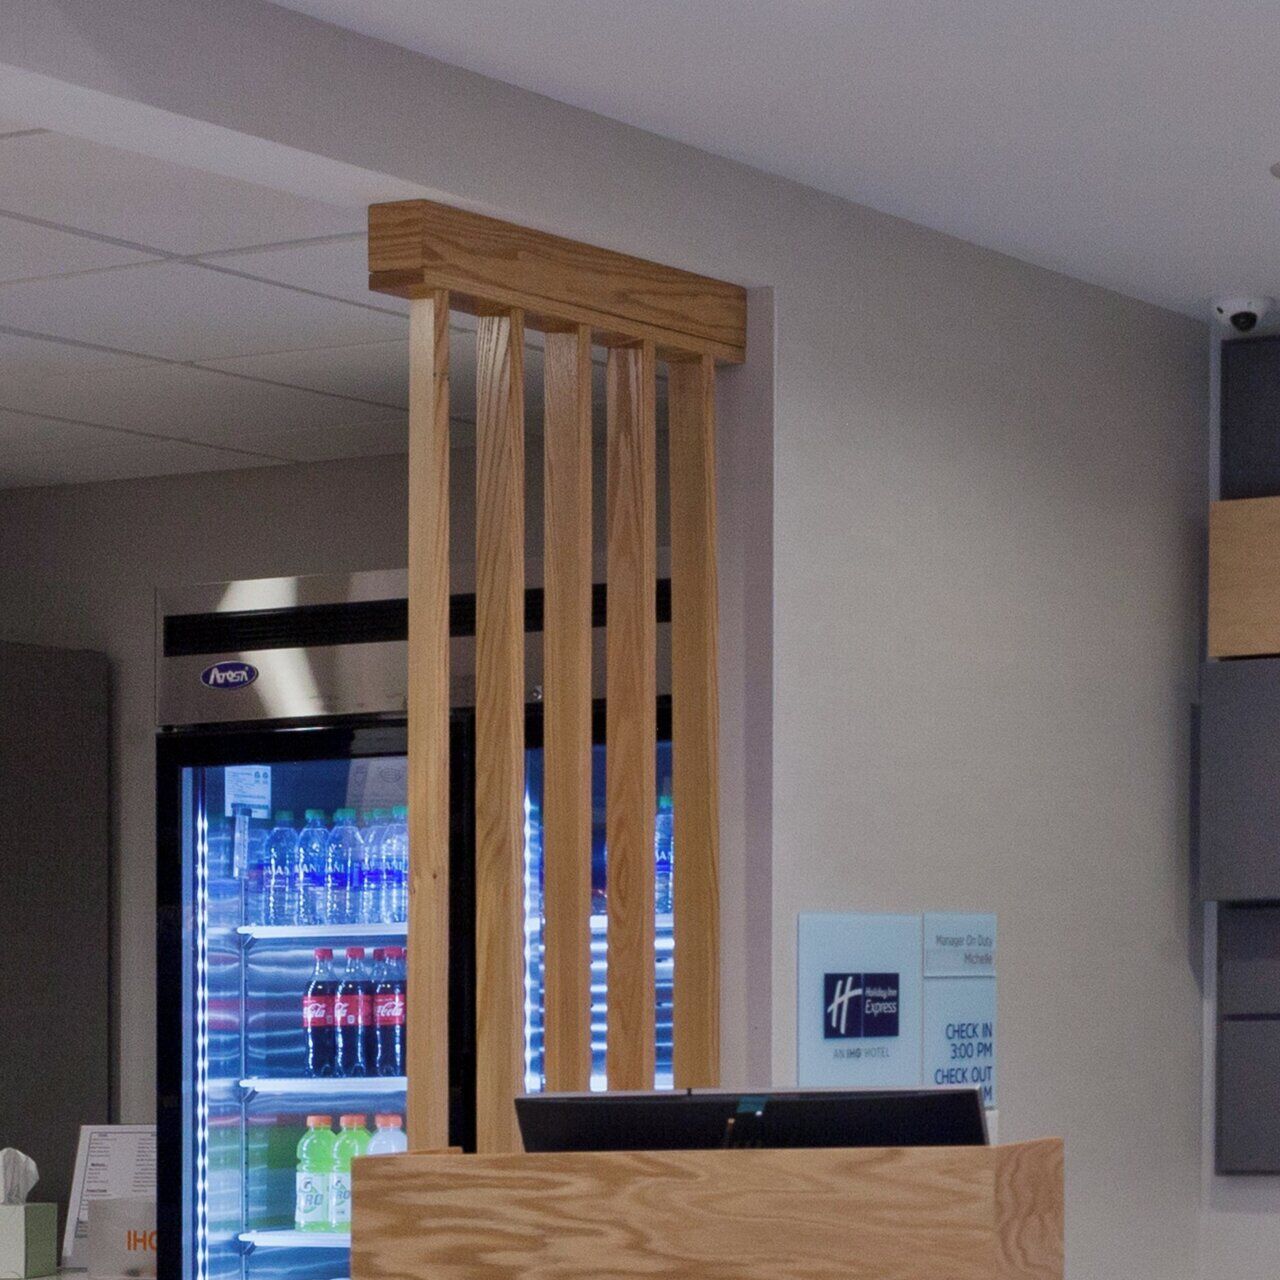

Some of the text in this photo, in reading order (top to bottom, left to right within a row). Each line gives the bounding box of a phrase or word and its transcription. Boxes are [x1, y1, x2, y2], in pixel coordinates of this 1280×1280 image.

[865, 986, 888, 999] Holiday
[865, 999, 897, 1017] Express
[945, 1022, 993, 1040] CHECK IN
[951, 1041, 993, 1059] 3:00 PM
[935, 1066, 993, 1085] CHECK OUT
